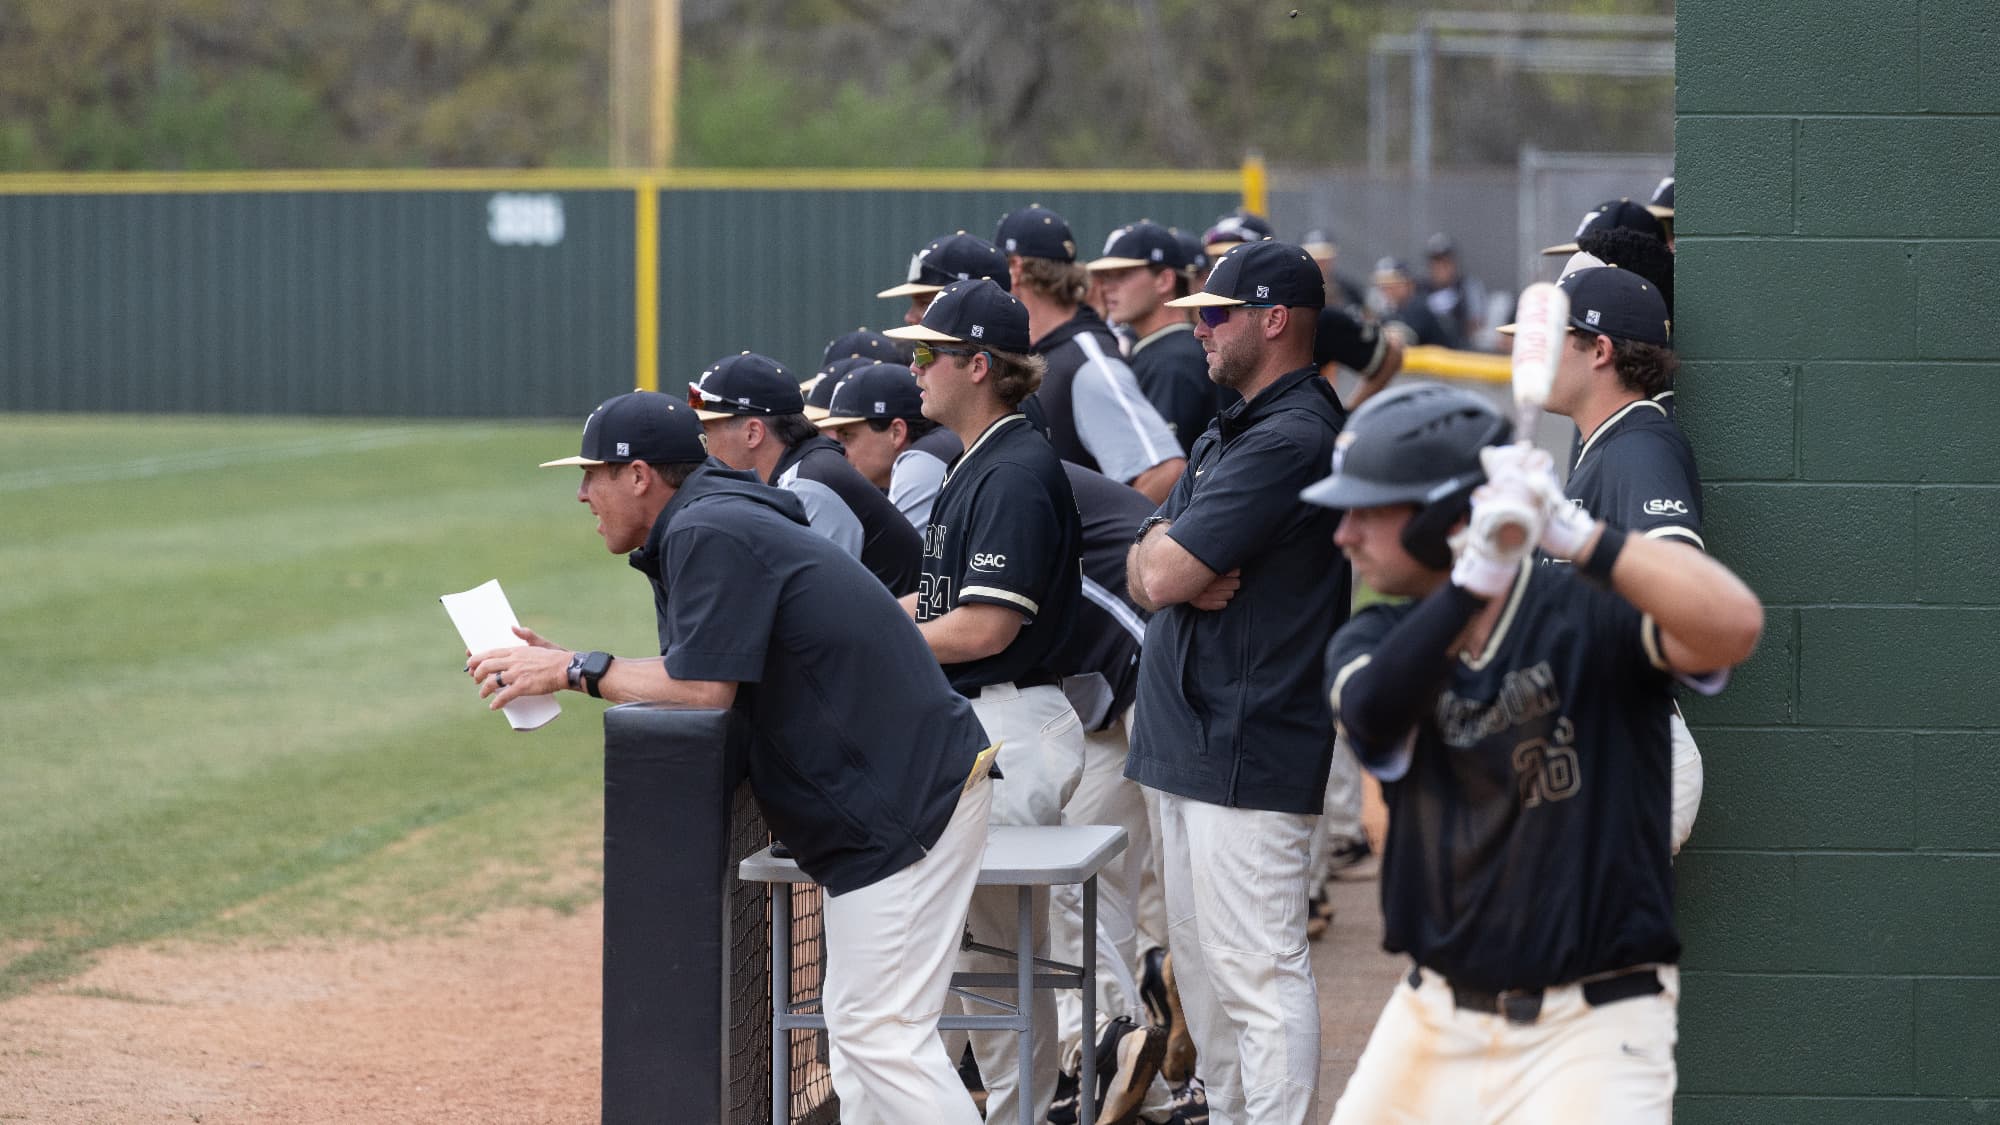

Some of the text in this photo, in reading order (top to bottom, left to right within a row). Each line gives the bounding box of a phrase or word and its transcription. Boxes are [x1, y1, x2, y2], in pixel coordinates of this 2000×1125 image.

[1648, 499, 1689, 515] SAC
[972, 553, 1007, 569] SAC
[915, 573, 951, 620] 34
